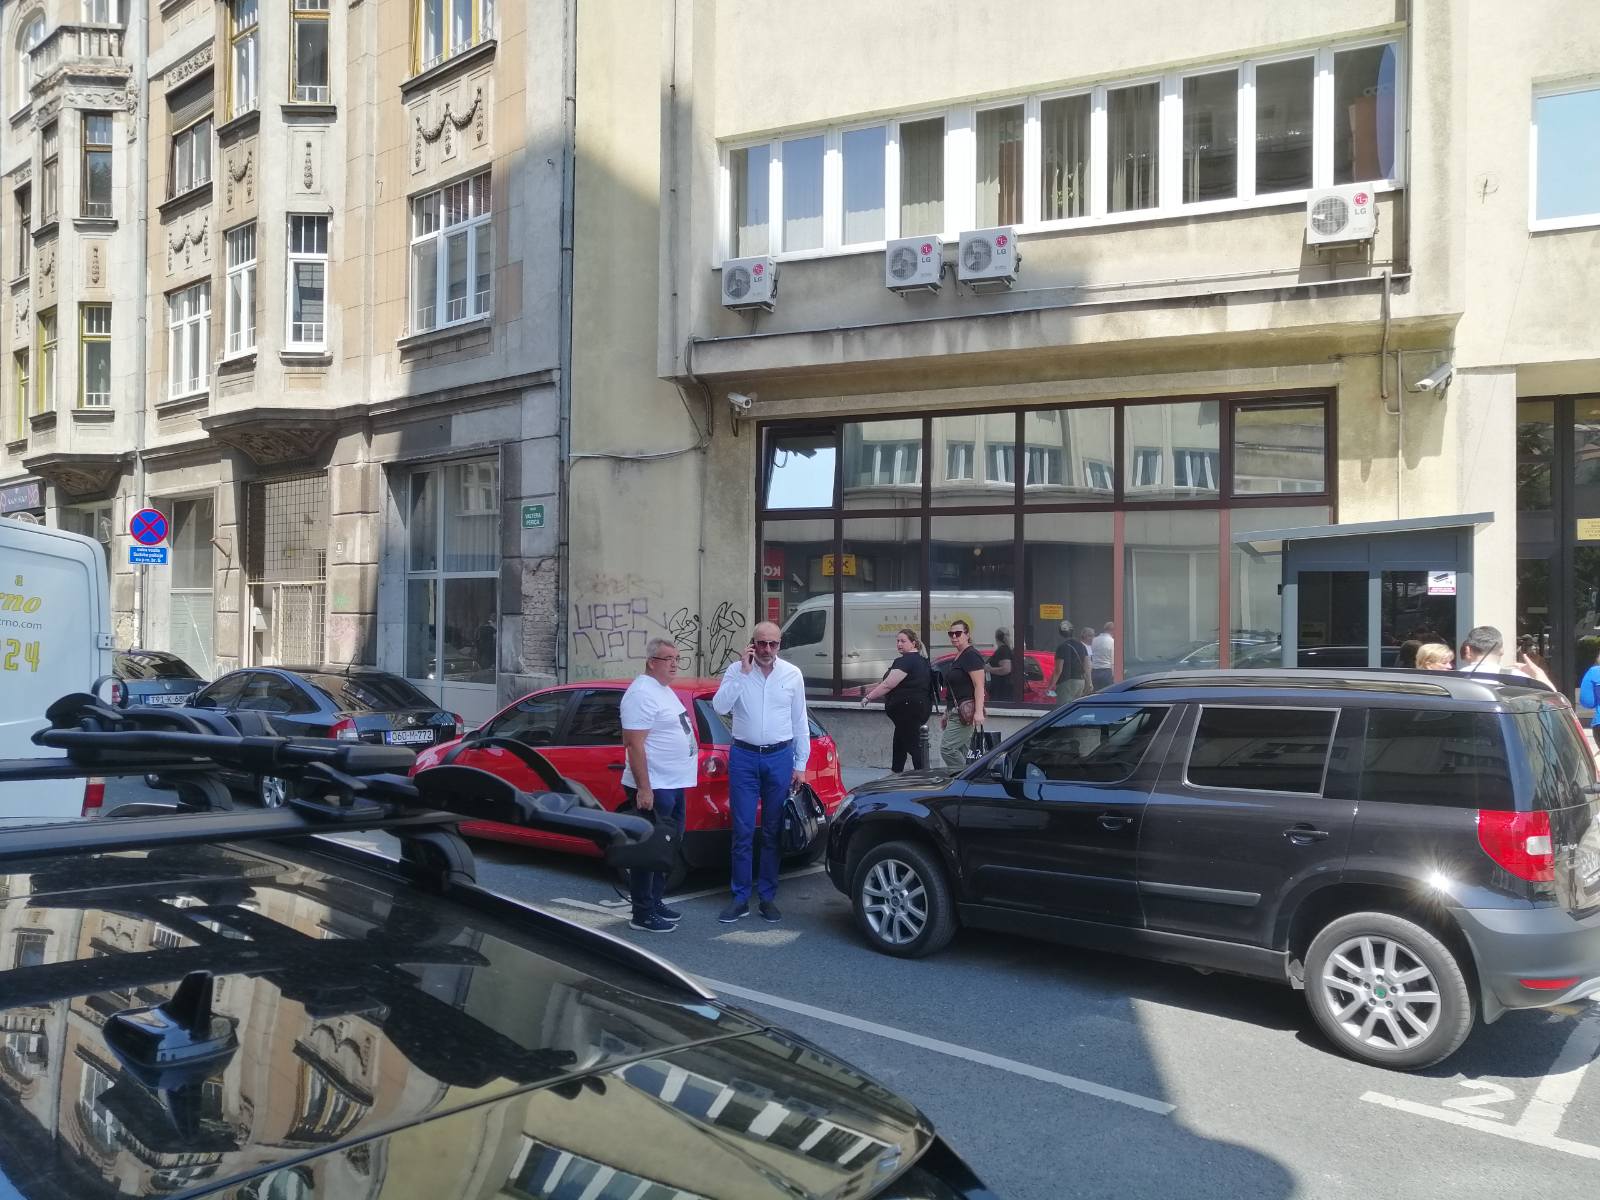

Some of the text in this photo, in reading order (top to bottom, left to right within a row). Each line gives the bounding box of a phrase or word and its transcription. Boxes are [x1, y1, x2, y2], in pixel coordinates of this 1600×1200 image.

[574, 597, 660, 631] UBER
[0, 638, 40, 673] 24
[1441, 1079, 1516, 1119] 2
